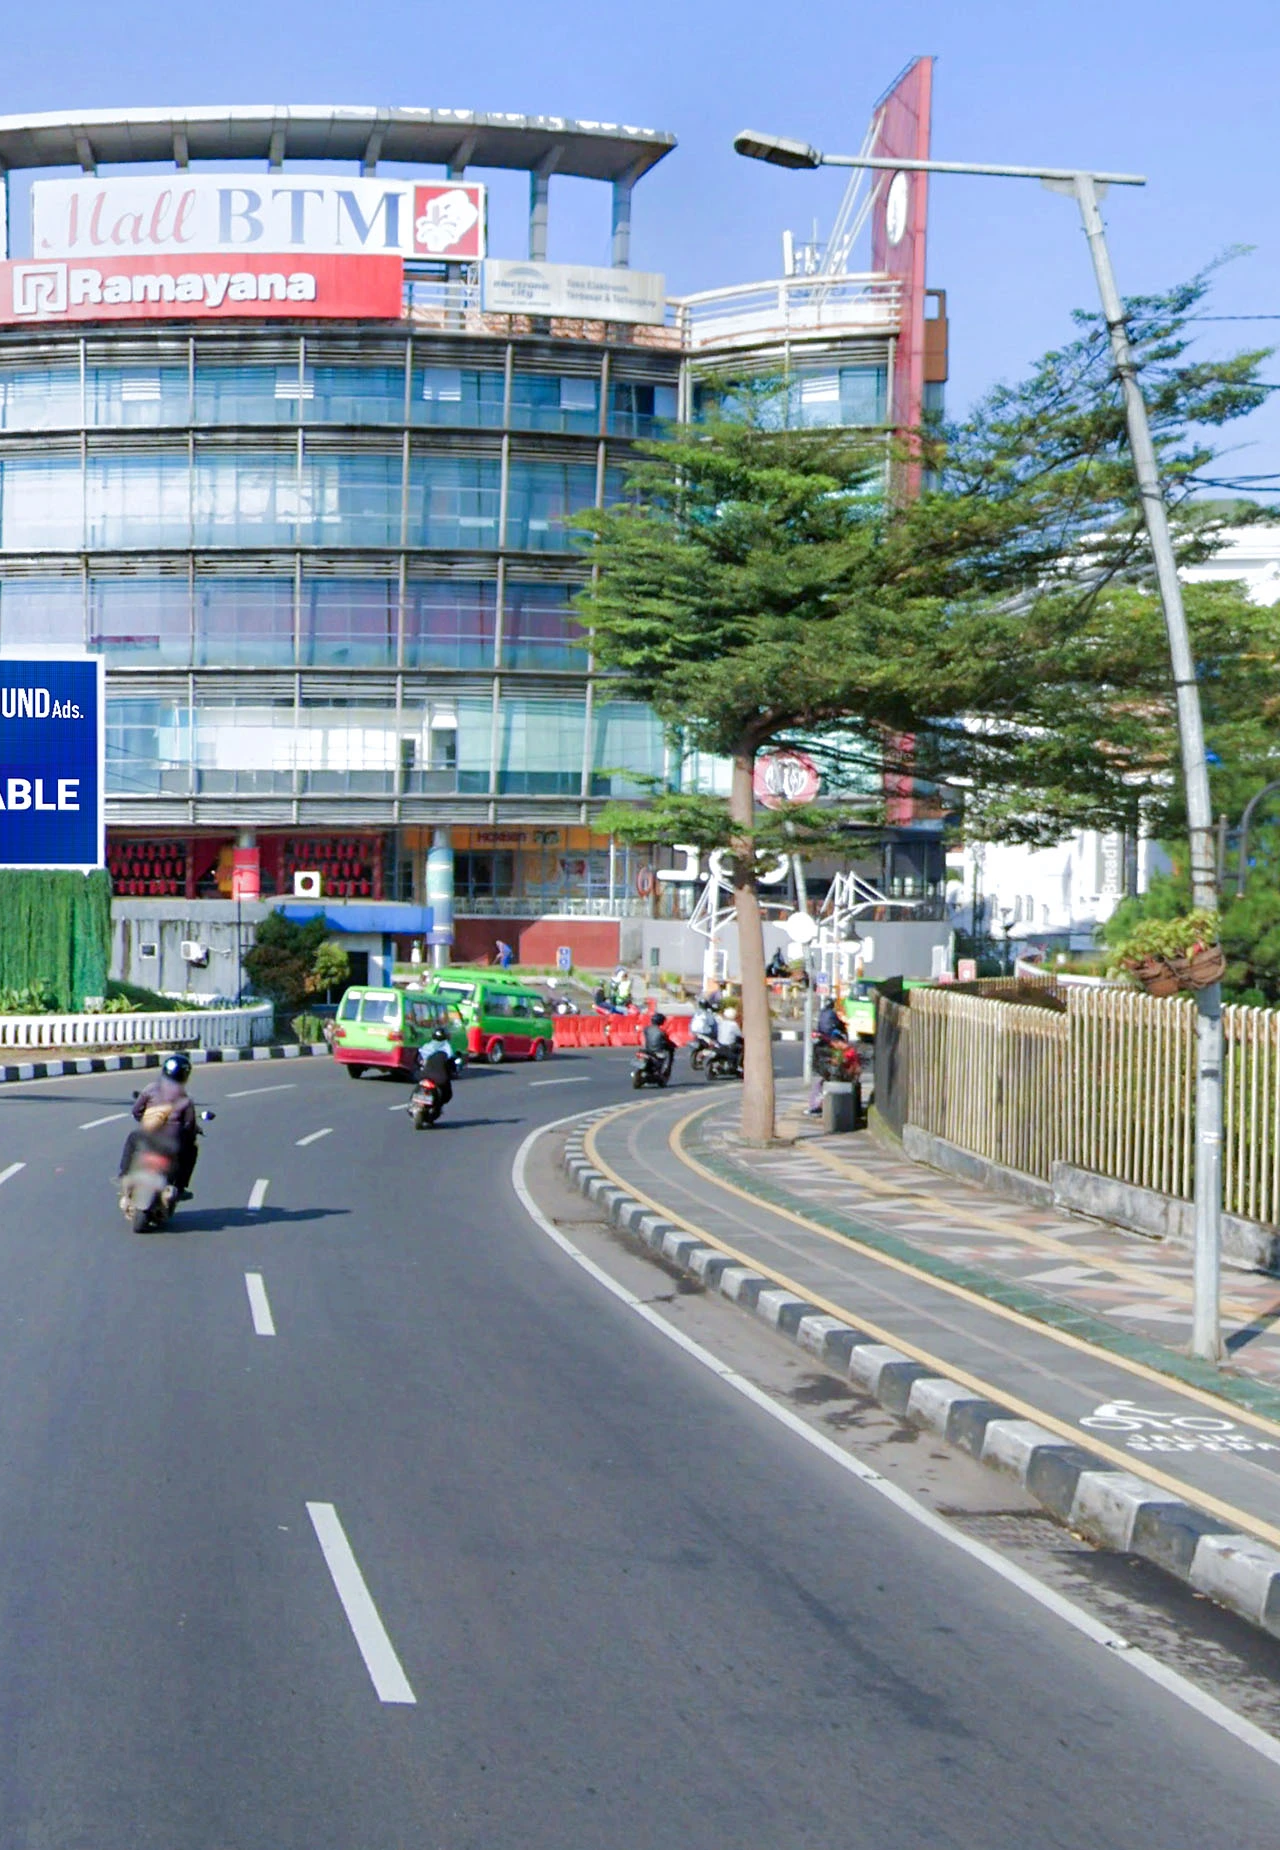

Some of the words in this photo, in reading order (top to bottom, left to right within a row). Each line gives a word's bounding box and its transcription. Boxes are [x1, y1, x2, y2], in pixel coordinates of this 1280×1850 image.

[41, 188, 196, 248] Mall
[216, 187, 408, 249] BTM
[69, 268, 317, 308] Ramayana
[51, 699, 84, 719] Ads.
